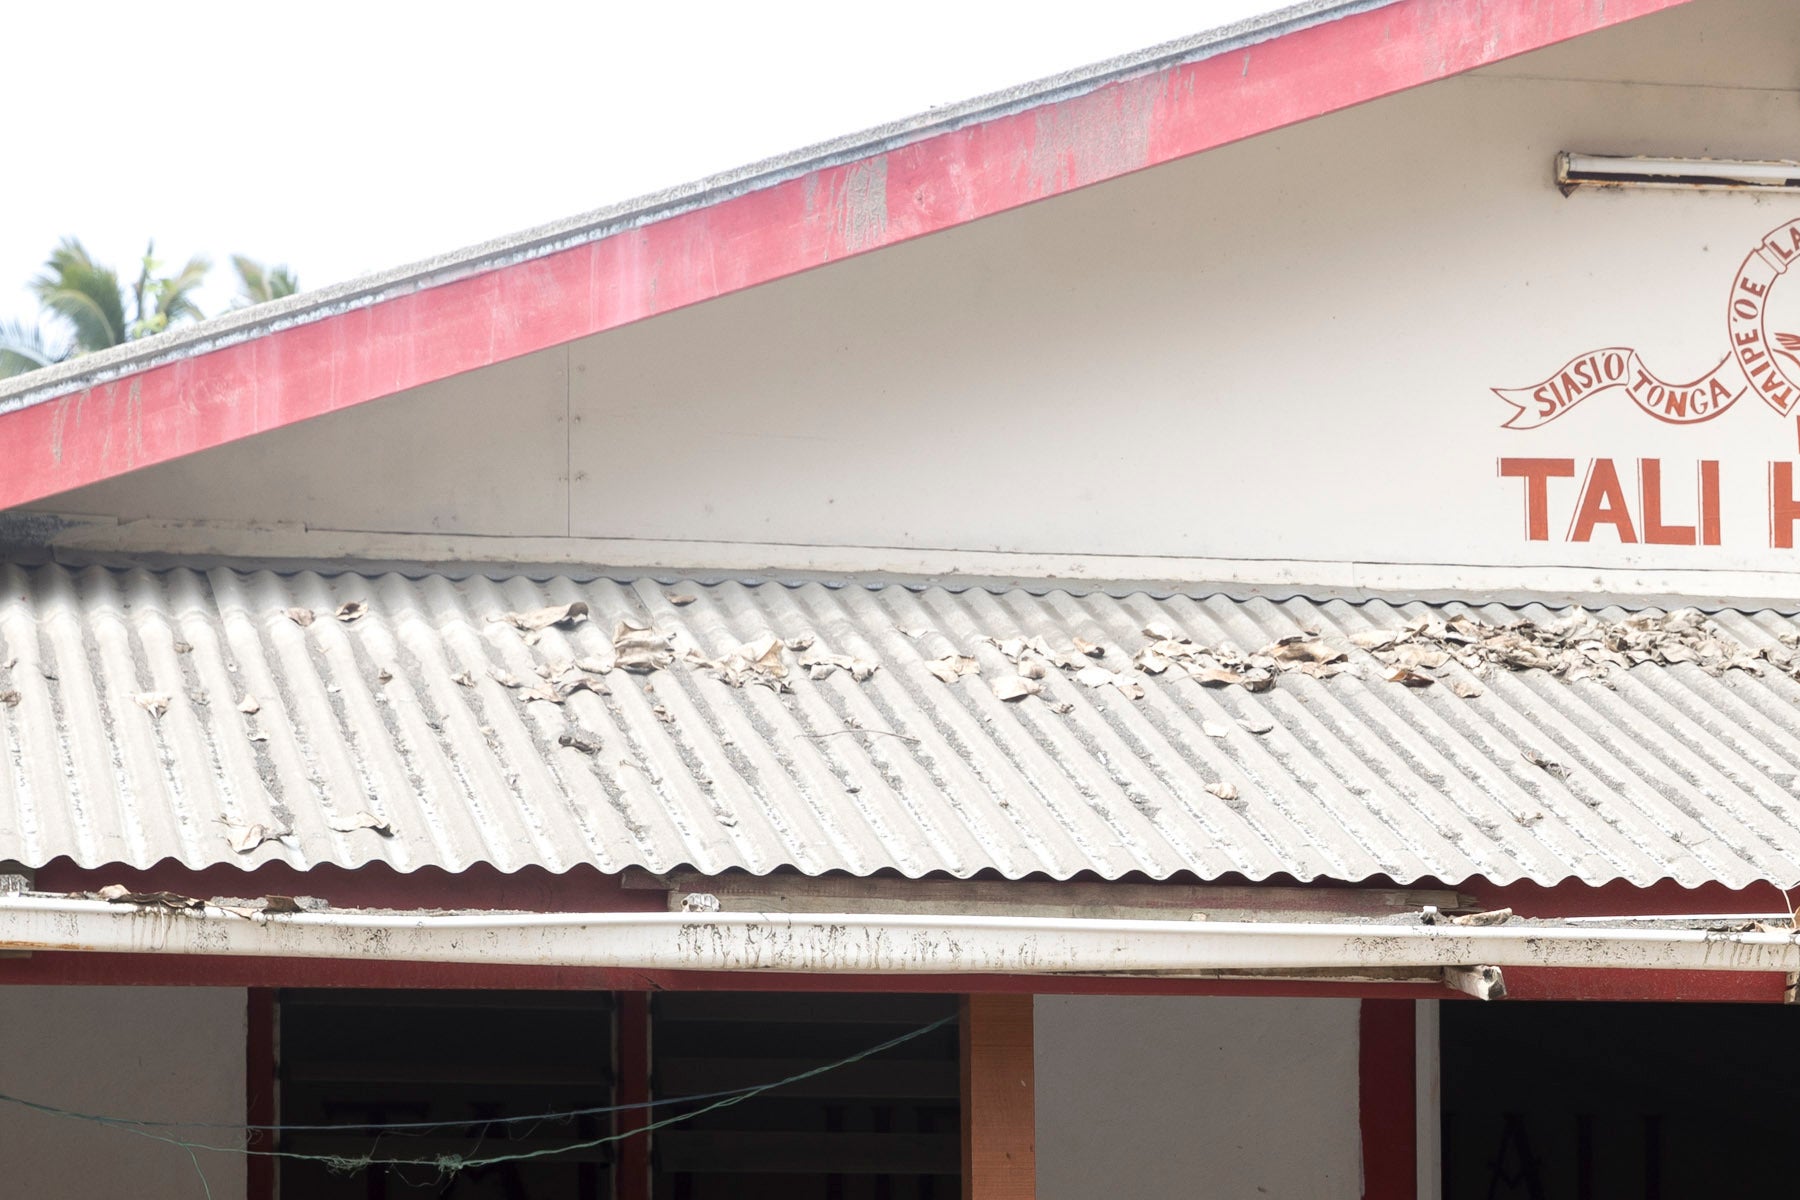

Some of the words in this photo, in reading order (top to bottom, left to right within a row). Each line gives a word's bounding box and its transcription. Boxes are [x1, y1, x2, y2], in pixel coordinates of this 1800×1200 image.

[1633, 369, 1732, 418] TONGA
[1734, 328, 1794, 410] TAIPE
[1498, 458, 1722, 546] TALI
